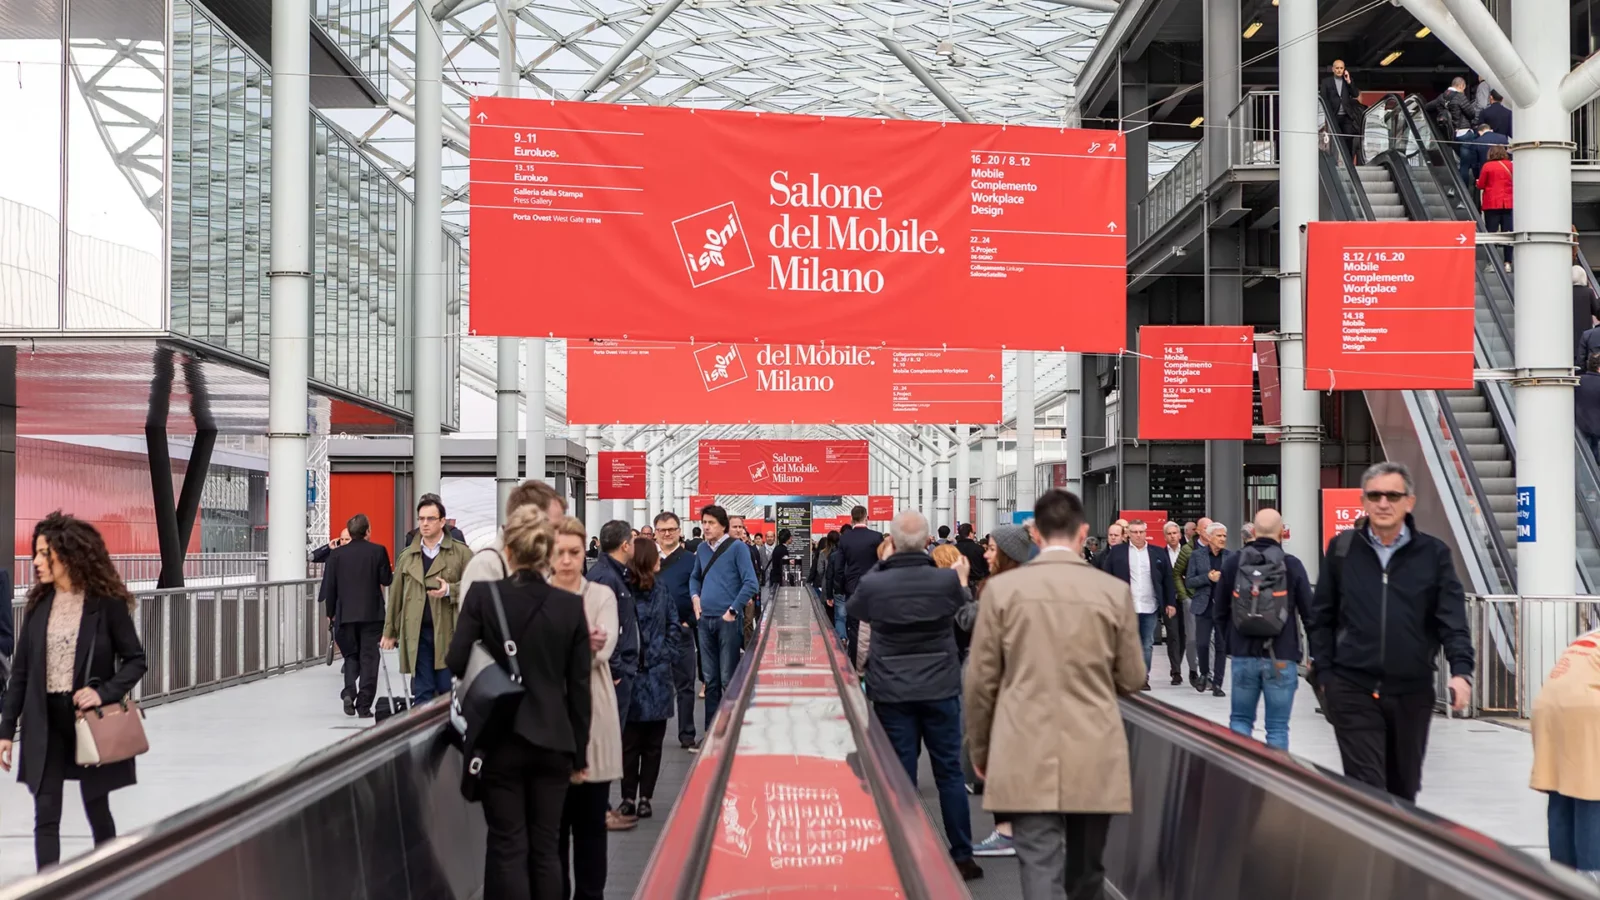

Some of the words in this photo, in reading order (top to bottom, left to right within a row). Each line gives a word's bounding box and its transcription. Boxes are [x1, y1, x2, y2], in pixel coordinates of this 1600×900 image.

[514, 146, 559, 158] Euroluce.
[514, 173, 549, 182] Euroluce
[971, 168, 1004, 179] Mobile
[769, 170, 883, 211] Salone
[971, 179, 1038, 192] Complemento
[513, 188, 539, 196] Galleria
[540, 189, 557, 197] della
[558, 190, 584, 199] Stampa
[971, 192, 1025, 205] Workplace
[513, 196, 529, 204] Press
[530, 197, 553, 206] Gallery
[971, 204, 1004, 217] Design
[532, 214, 552, 222] Ovest
[570, 215, 584, 223] Gate
[769, 213, 822, 250] del
[826, 215, 946, 254] Mobile.
[687, 212, 738, 273] isaloni
[970, 246, 997, 254] S.Project
[1343, 262, 1379, 271] Mobile
[768, 255, 885, 294] Milano
[1343, 273, 1415, 284] Complemento
[1343, 283, 1397, 294] Workplace
[1343, 294, 1378, 306] Design
[1342, 335, 1377, 343] Workplace
[1342, 343, 1365, 351] Design
[756, 344, 791, 366] del
[795, 344, 875, 366] Mobile.
[703, 345, 738, 383] isaloni
[1164, 361, 1212, 369] Complemento
[756, 369, 834, 392] Milano
[1164, 376, 1188, 384] Design
[772, 452, 803, 462] Salone
[772, 463, 786, 472] del
[787, 463, 819, 473] Mobile.
[772, 473, 803, 483] Milano
